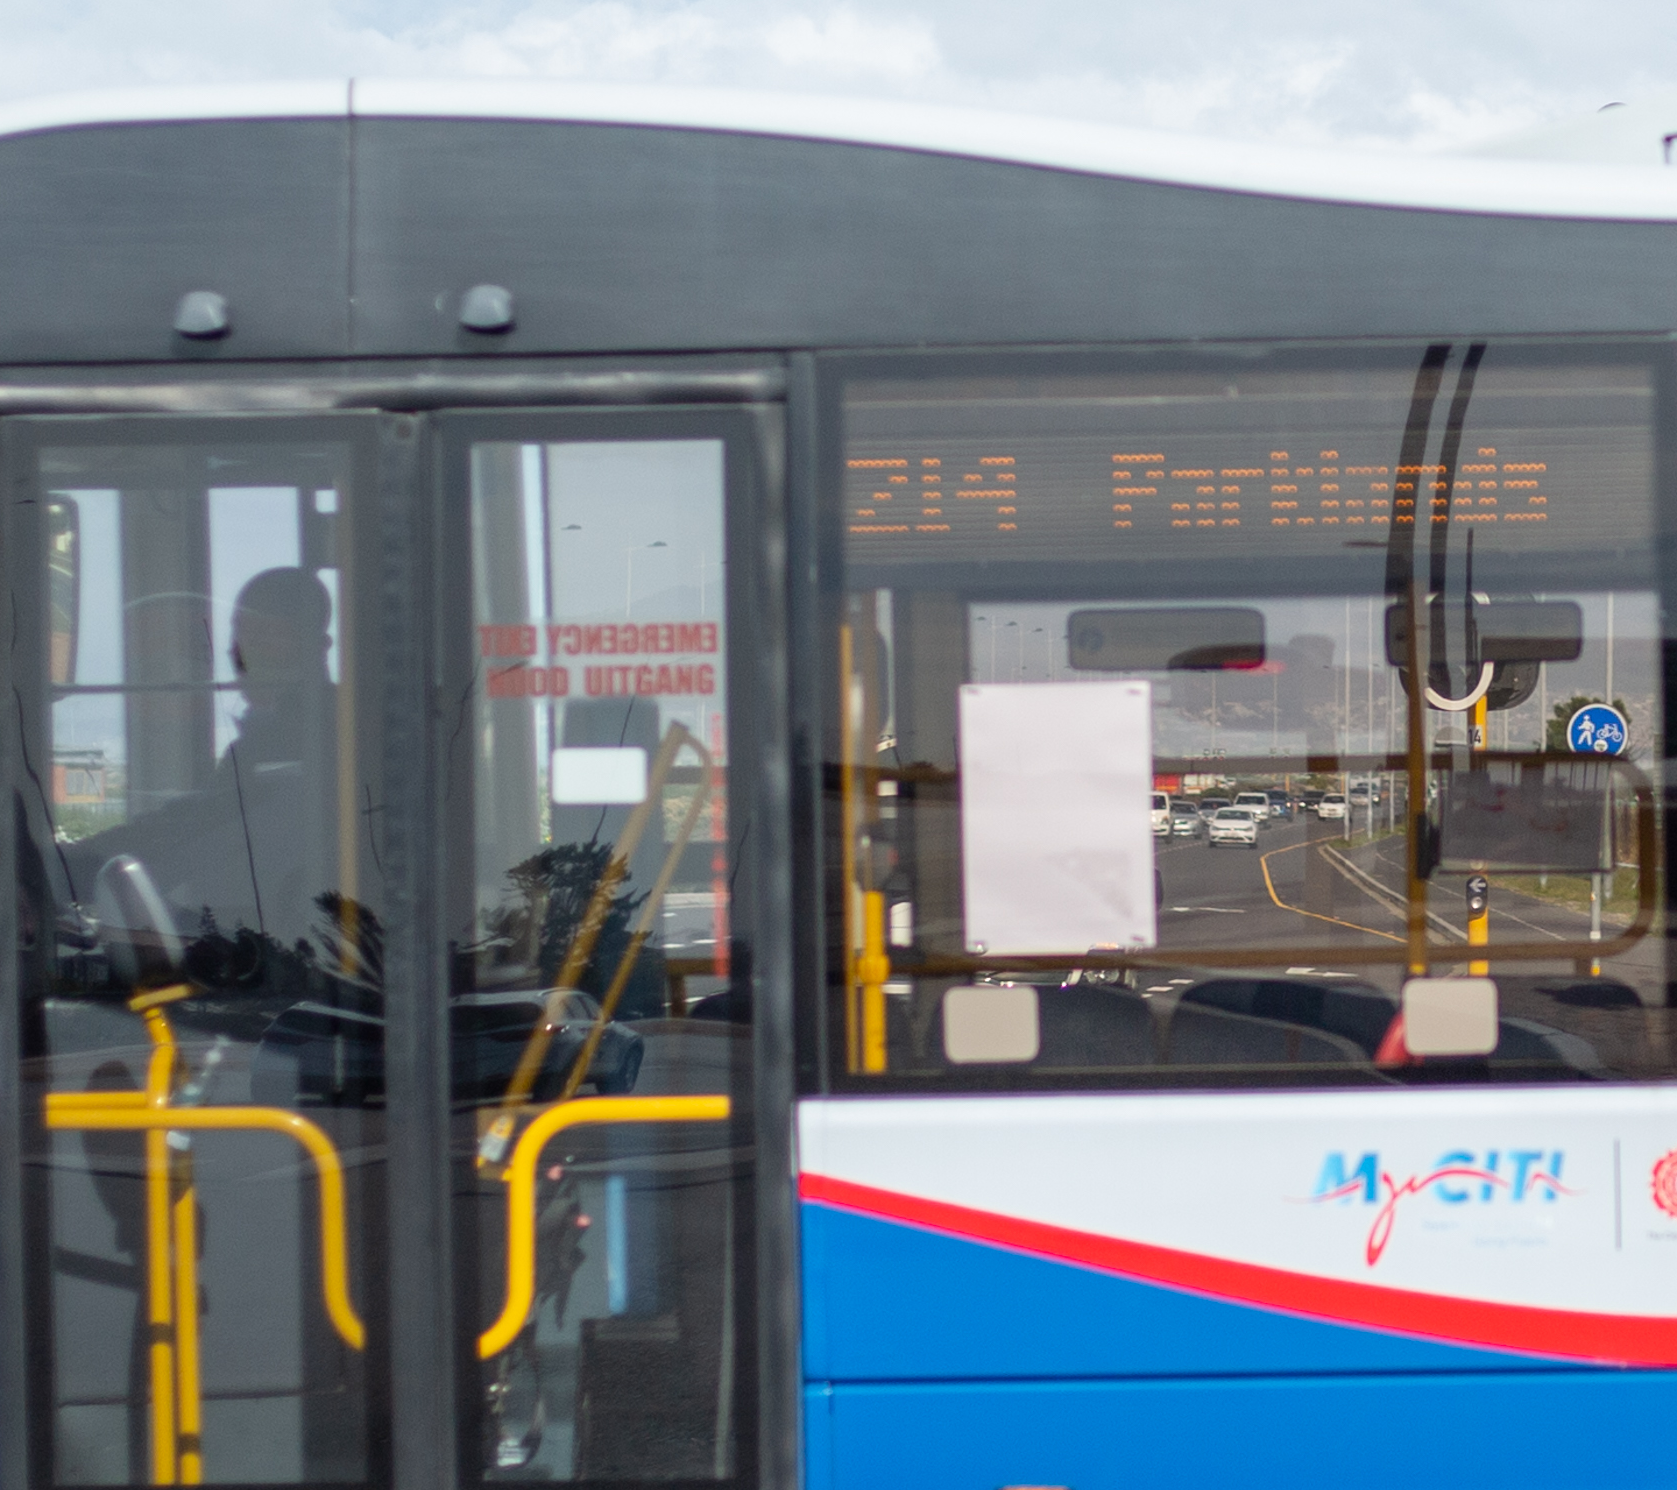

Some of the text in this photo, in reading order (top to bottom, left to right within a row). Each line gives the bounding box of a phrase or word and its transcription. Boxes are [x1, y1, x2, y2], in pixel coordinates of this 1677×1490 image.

[847, 446, 1548, 532] 214 Parklands
[584, 663, 715, 696] UITGANG
[1468, 728, 1482, 745] 14
